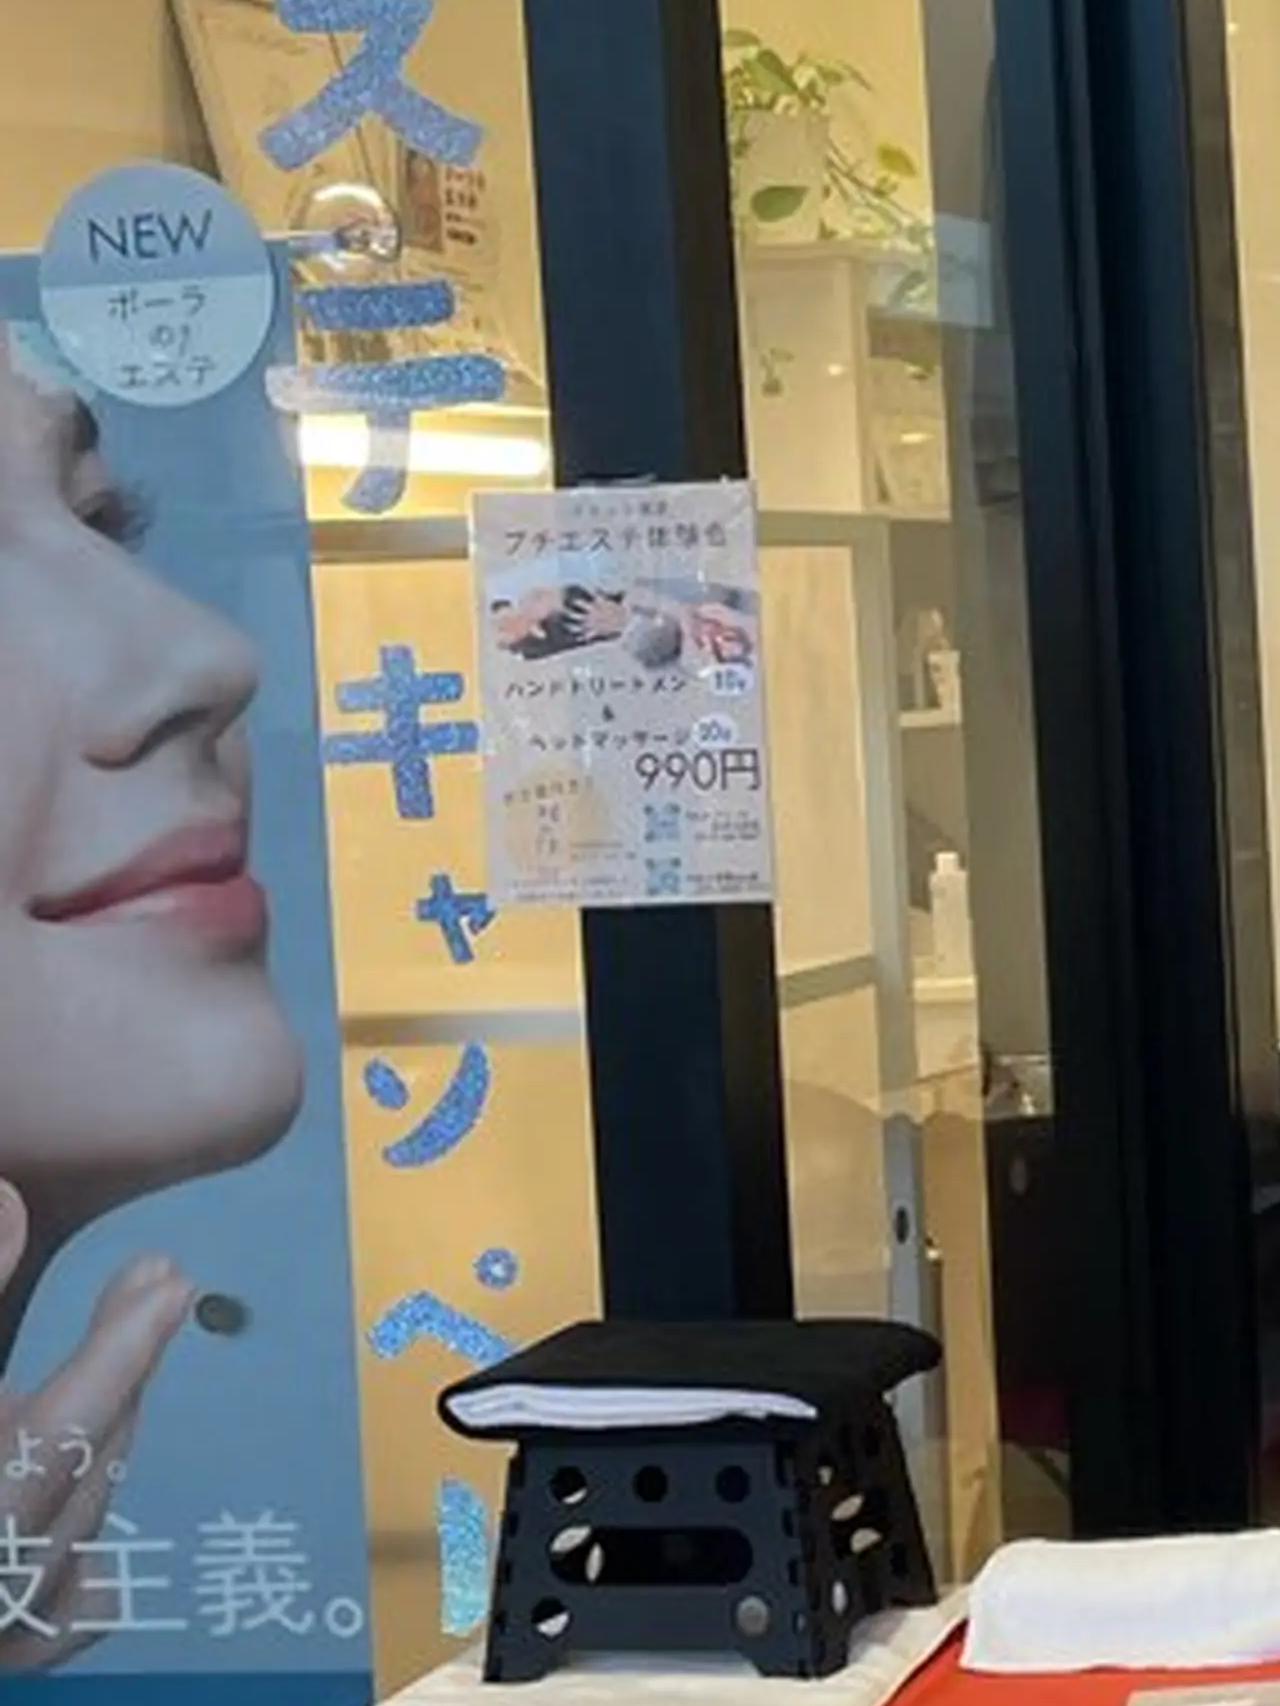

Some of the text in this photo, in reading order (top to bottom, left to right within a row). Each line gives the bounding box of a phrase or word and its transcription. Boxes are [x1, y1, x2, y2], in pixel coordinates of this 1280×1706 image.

[87, 207, 214, 265] NEW
[107, 286, 207, 322] ポーラ
[117, 354, 218, 390] エステ
[634, 747, 763, 793] 990円
